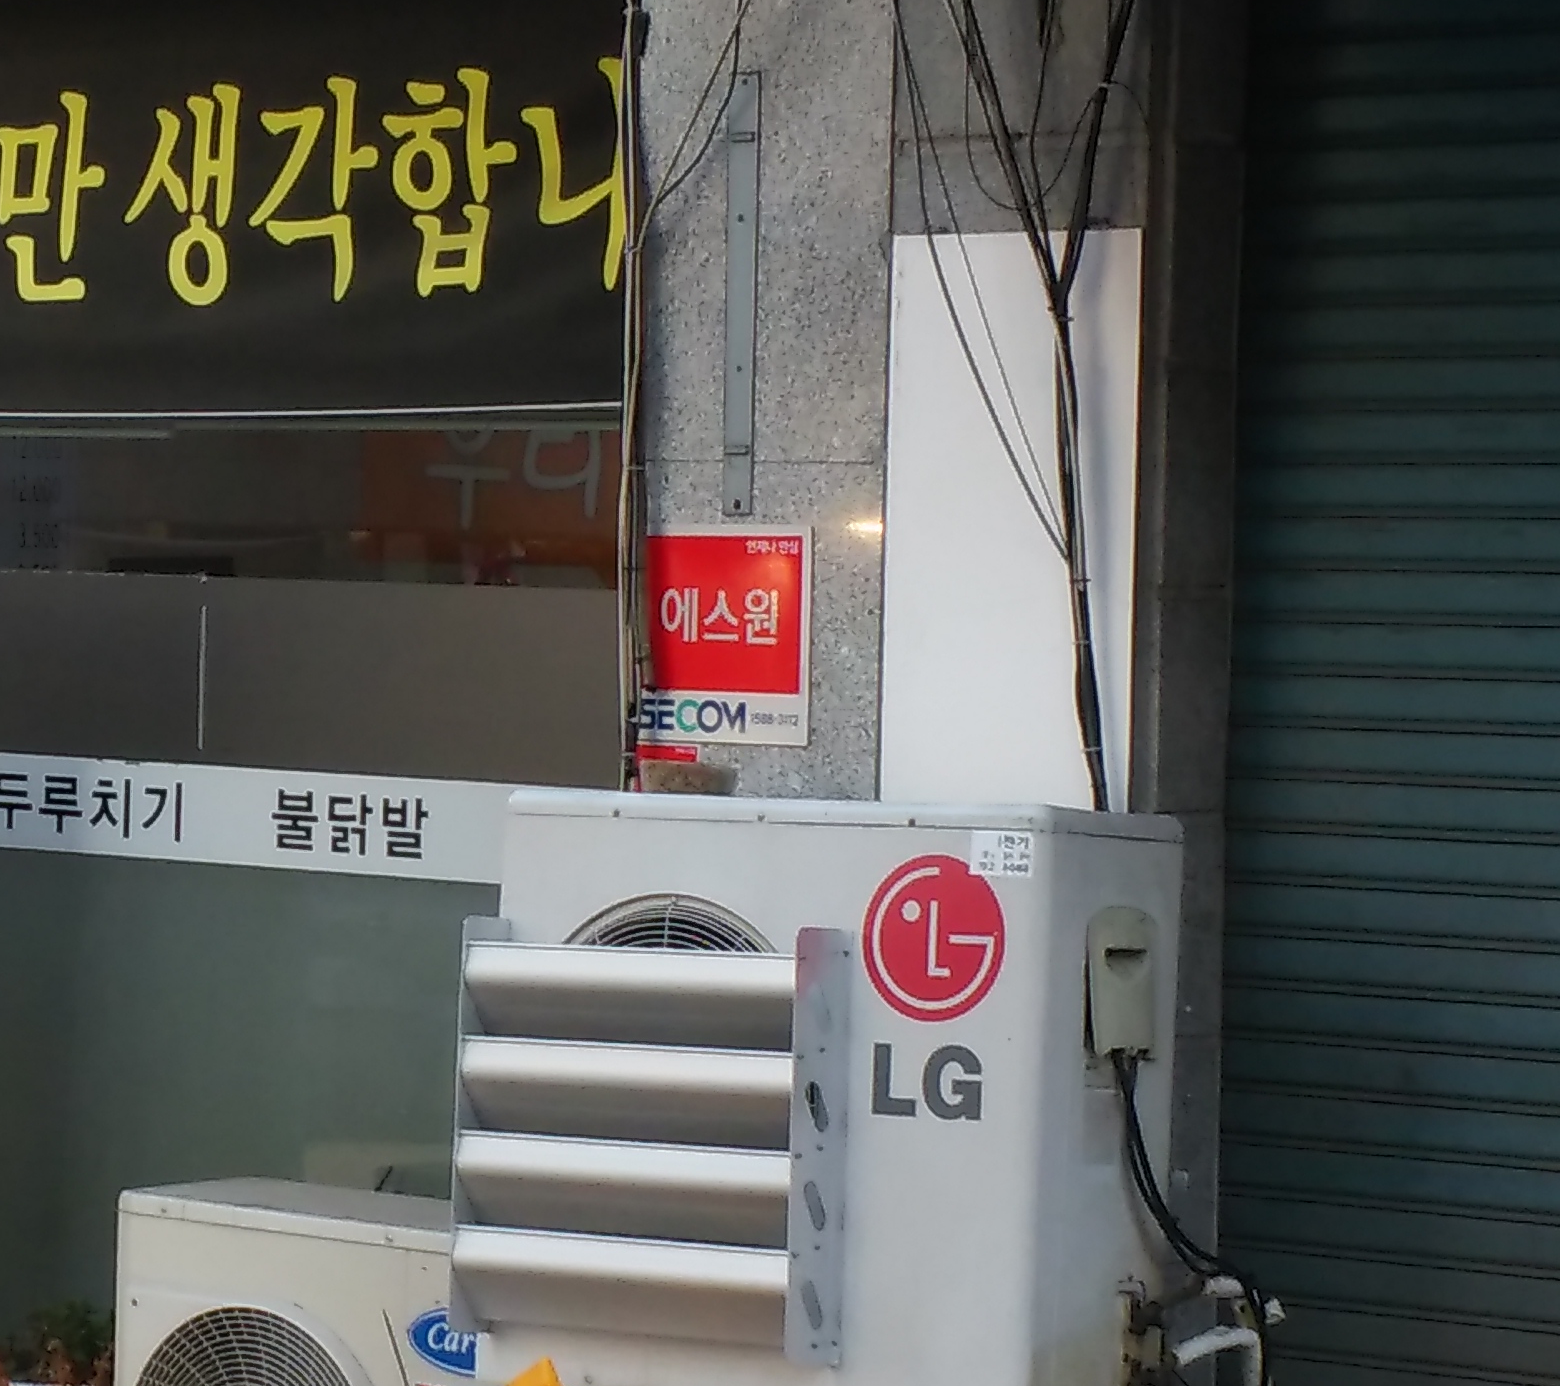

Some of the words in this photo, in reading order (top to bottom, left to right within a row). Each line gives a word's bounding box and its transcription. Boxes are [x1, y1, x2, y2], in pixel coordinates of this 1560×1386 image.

[660, 586, 780, 646] 에스원
[639, 697, 749, 735] SECOM
[271, 786, 430, 861] 불닭발
[869, 1042, 984, 1121] LG
